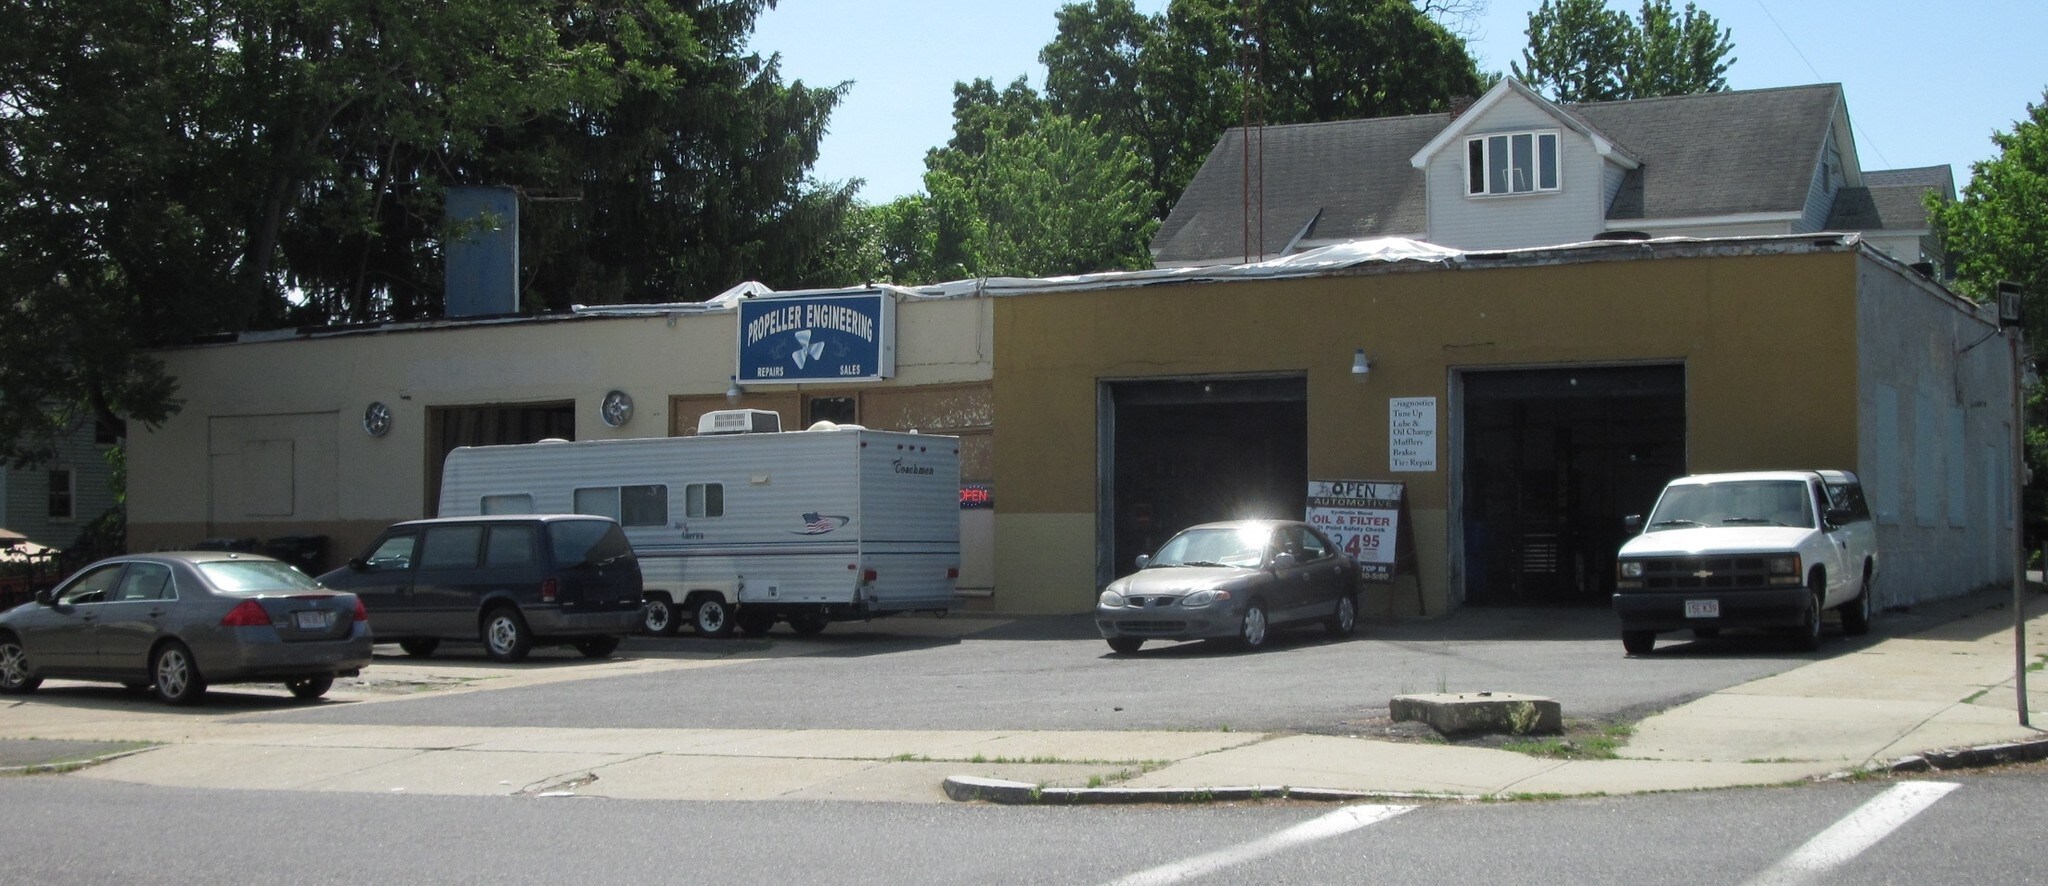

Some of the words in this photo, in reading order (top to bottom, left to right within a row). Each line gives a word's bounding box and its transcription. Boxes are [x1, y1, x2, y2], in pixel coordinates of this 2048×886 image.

[747, 305, 801, 347] PROPELLER
[806, 304, 873, 343] ENGINEERING
[757, 366, 784, 377] REPAIRS
[840, 364, 860, 375] SALES
[1412, 409, 1423, 418] Up
[1393, 428, 1405, 436] Oil
[1406, 428, 1433, 436] Change
[1393, 438, 1423, 446] Mufflers
[893, 461, 934, 475] Coachmen
[1410, 459, 1433, 468] Repair
[960, 489, 987, 501] OPEN
[1332, 482, 1376, 498] OPEN
[1314, 498, 1392, 508] AUTOMOTIVE
[1312, 514, 1331, 524] OIL
[1336, 515, 1345, 525] &
[1350, 516, 1390, 526] FILTER
